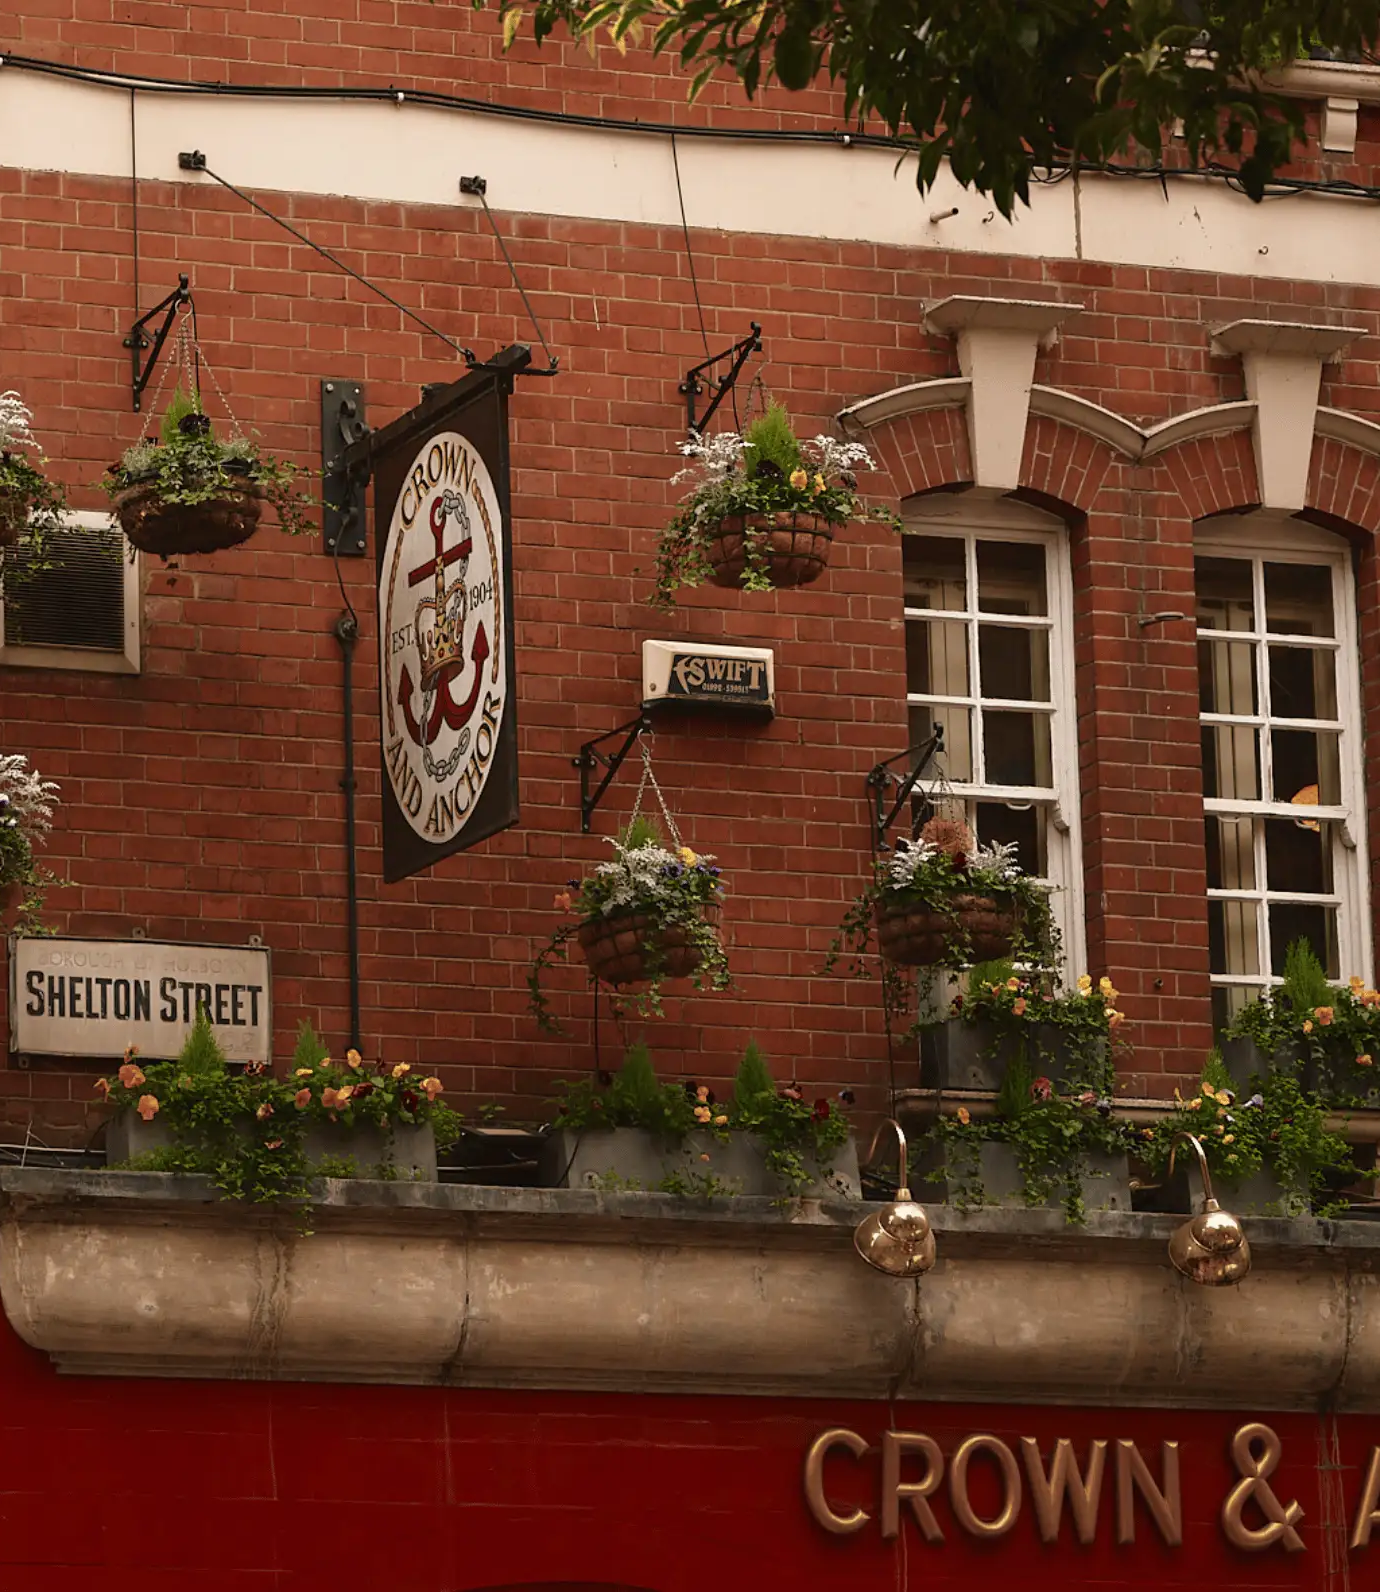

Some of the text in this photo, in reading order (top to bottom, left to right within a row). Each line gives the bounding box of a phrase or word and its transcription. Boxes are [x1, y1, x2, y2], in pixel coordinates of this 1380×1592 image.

[401, 442, 475, 528] CROWN
[391, 580, 494, 656] EST. 1904
[687, 658, 765, 690] SWIFT
[387, 694, 502, 835] AND ANCHOR
[26, 970, 263, 1027] SHELTON STREET
[804, 1427, 1183, 1548] CROWN
[1221, 1422, 1308, 1553] &
